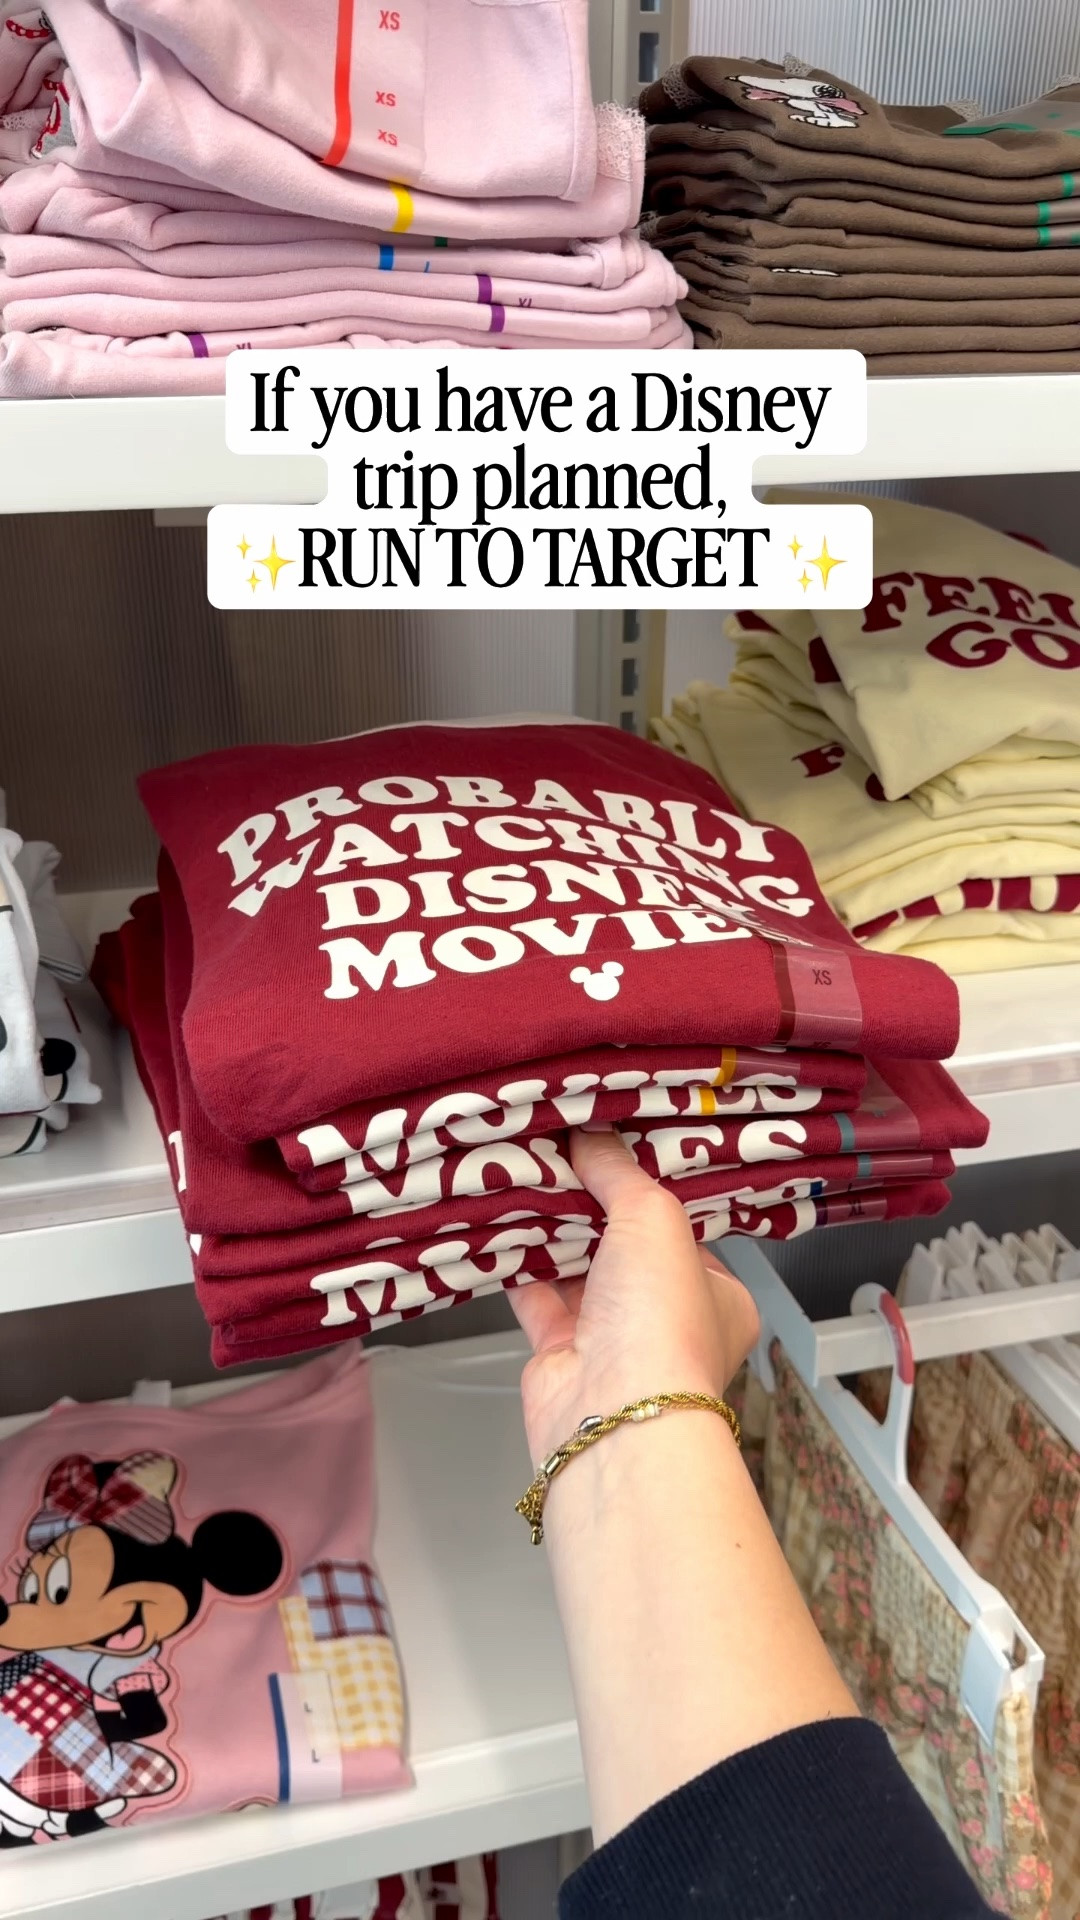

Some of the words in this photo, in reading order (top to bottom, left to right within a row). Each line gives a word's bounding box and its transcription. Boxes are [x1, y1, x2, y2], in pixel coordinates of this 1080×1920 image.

[379, 9, 401, 31] XS
[375, 90, 397, 107] XS
[377, 128, 398, 147] XS
[217, 775, 776, 888] PROBABLY
[227, 812, 816, 918] WATCHING
[318, 909, 780, 1000] MOVIE
[812, 969, 833, 986] XS
[338, 1119, 808, 1218] MOES
